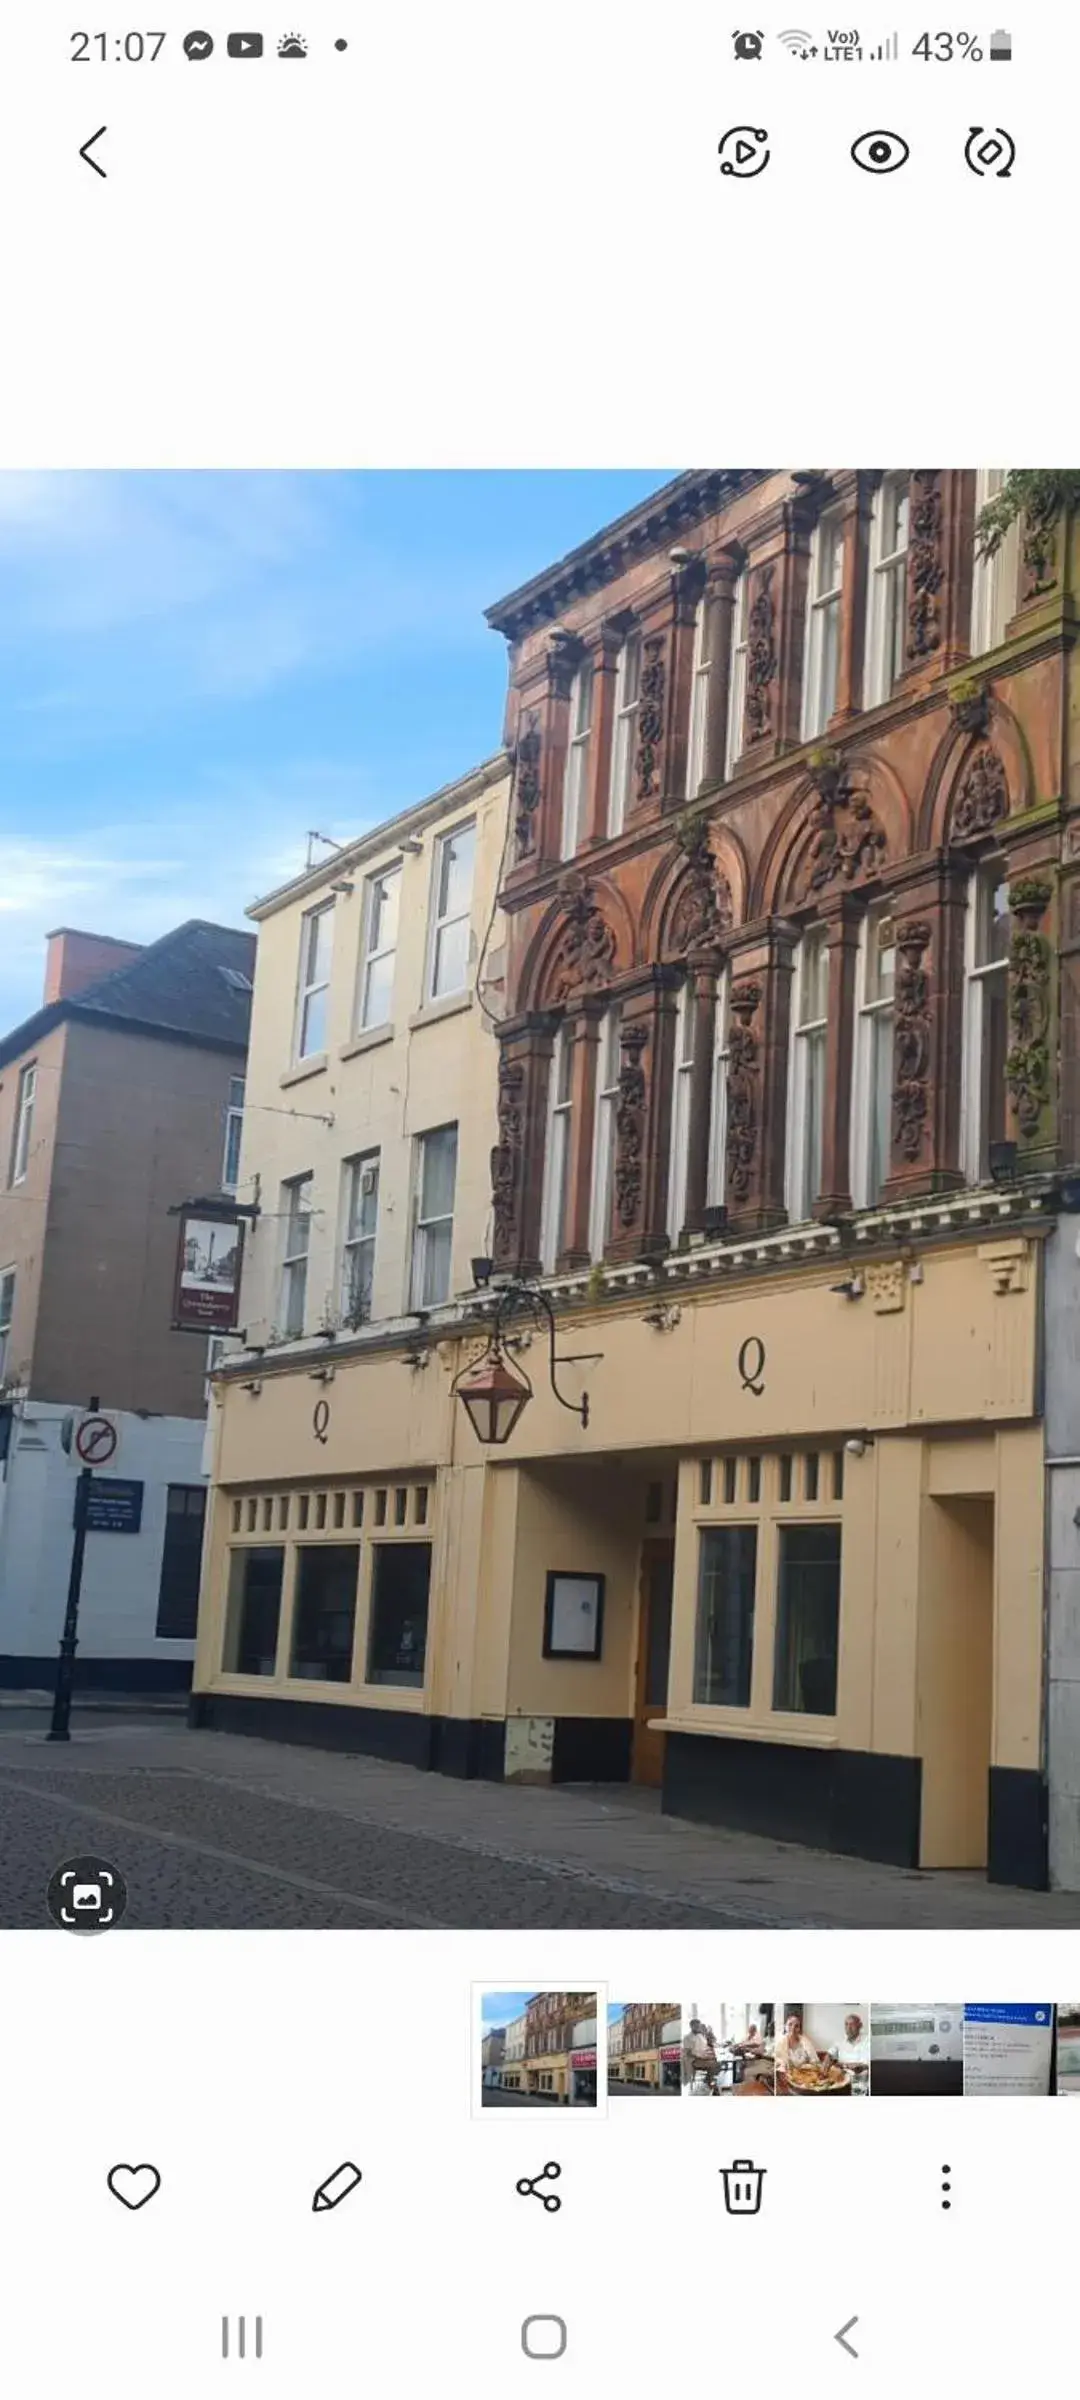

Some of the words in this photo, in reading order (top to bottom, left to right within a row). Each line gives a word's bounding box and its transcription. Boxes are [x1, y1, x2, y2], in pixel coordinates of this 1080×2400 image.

[200, 1292, 214, 1301] The
[738, 1336, 765, 1396] Q
[313, 1400, 329, 1445] Q
